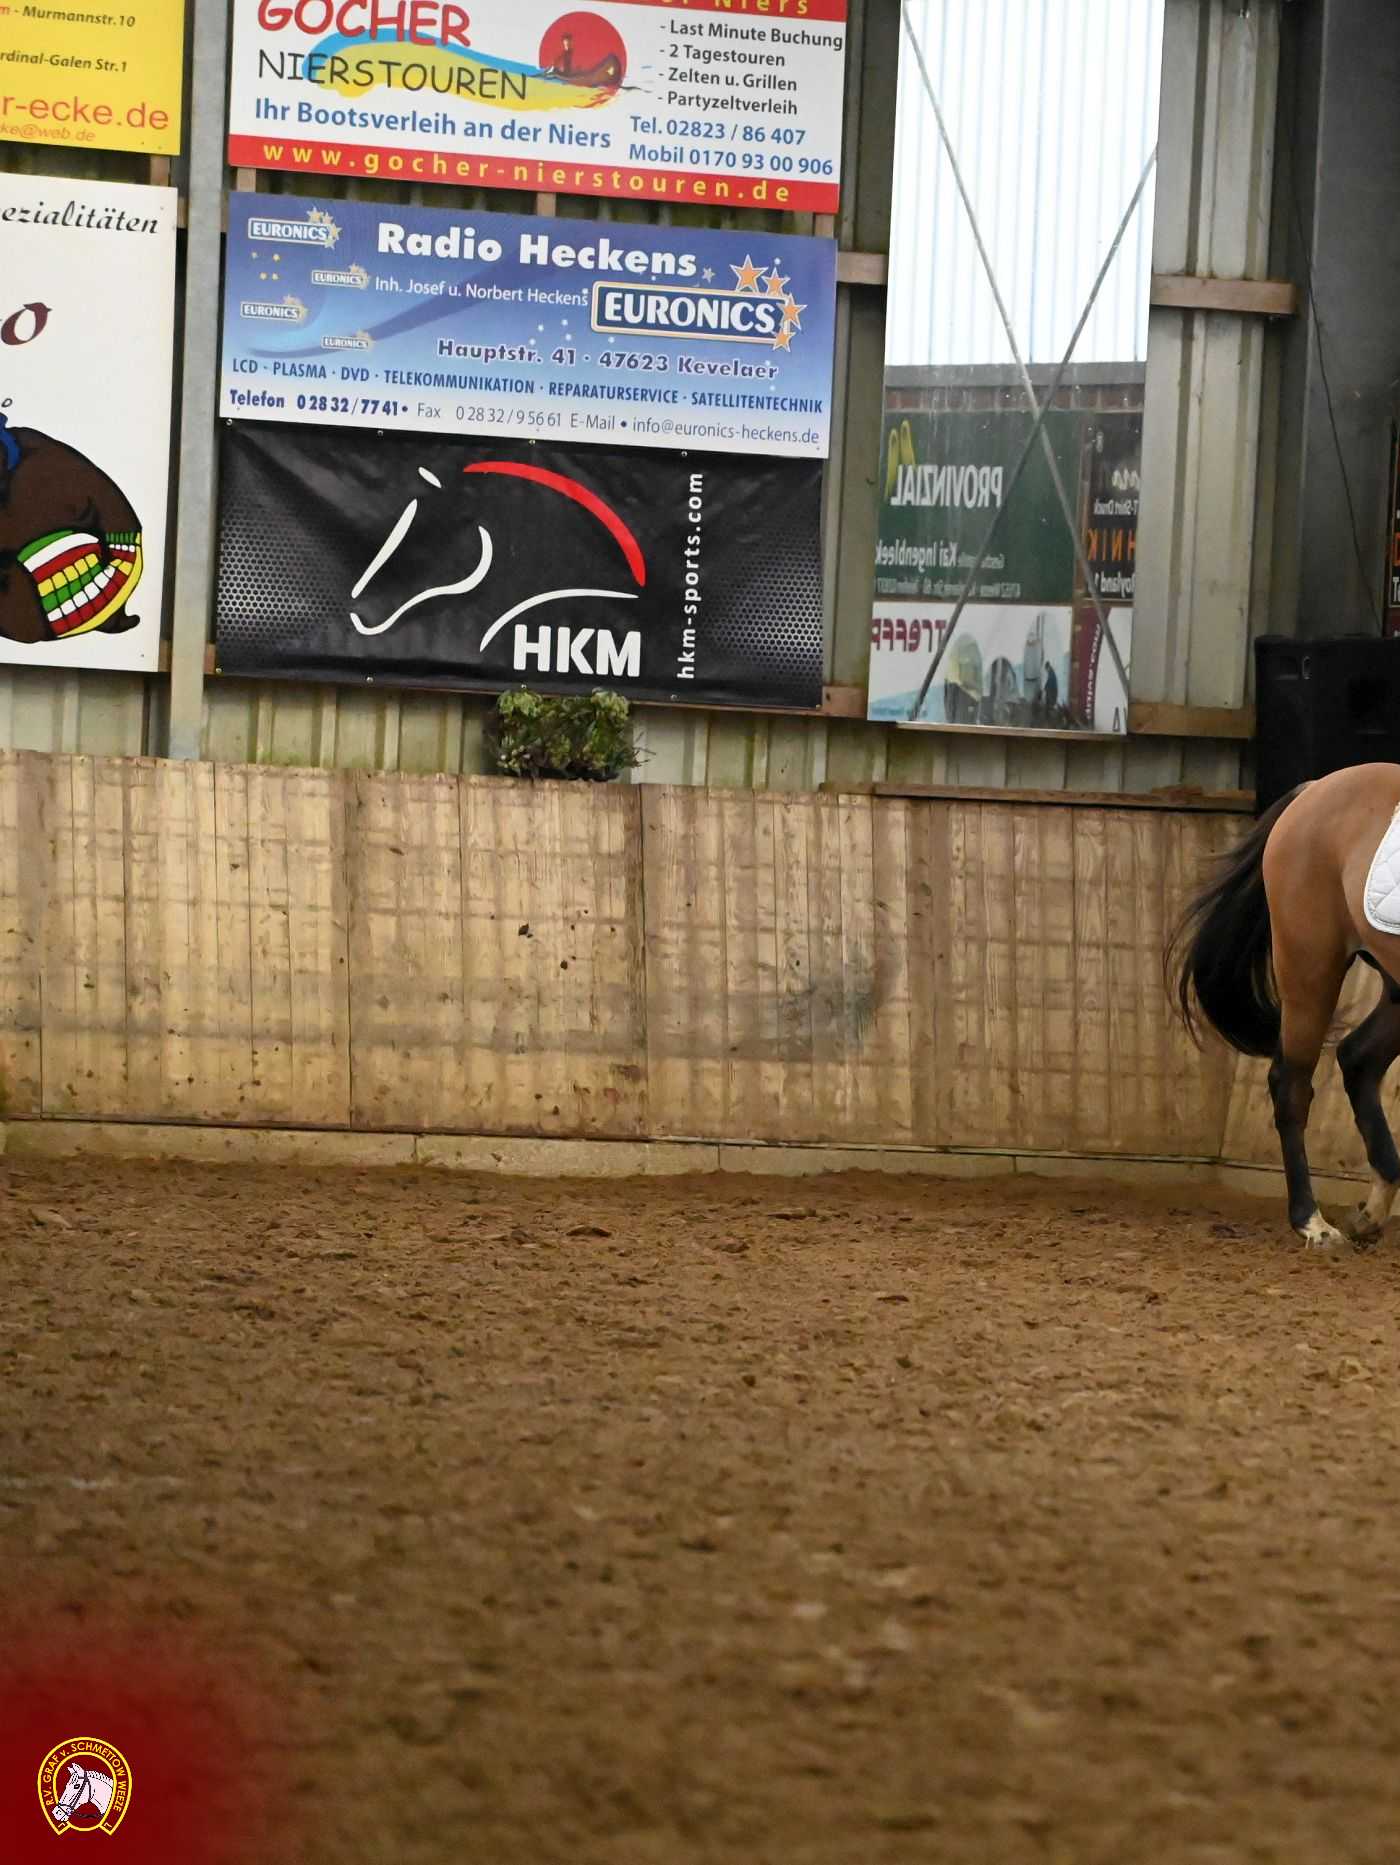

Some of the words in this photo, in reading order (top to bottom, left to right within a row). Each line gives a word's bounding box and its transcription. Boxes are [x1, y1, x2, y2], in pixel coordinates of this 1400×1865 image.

[257, 0, 471, 47] GOCHER
[670, 19, 704, 37] Last
[708, 23, 767, 42] Minute
[770, 28, 844, 52] Buchung
[669, 44, 679, 59] 2
[685, 45, 786, 67] Tagestouren
[258, 49, 527, 100] NIERSTOUREN
[668, 67, 721, 86] Zelten
[725, 73, 740, 87] u.
[743, 74, 798, 92] Grillen
[2, 96, 169, 130] r-ecke.de
[668, 91, 799, 116] Partyzeltverleih
[255, 97, 291, 121] Ihr
[298, 101, 456, 136] Bootsverleih
[464, 120, 493, 138] an
[500, 118, 541, 143] der
[549, 123, 611, 148] Niers
[630, 116, 662, 136] Tel.
[667, 119, 725, 140] 02823
[742, 126, 766, 143] 86
[770, 128, 806, 145] 407
[629, 144, 684, 164] Mobil
[689, 148, 737, 168] 0170
[742, 152, 765, 170] 93
[770, 155, 793, 173] 00
[798, 158, 834, 176] 906
[1, 201, 161, 234] ezialitäten
[252, 223, 328, 241] EURONICS
[378, 222, 502, 262] Radio
[519, 234, 697, 277] Heckens
[314, 272, 362, 285] EURONICS
[375, 276, 402, 292] Inh.
[406, 279, 444, 296] Josef
[448, 285, 462, 297] u.
[465, 284, 524, 302] Norbert
[527, 288, 588, 307] Heckens
[243, 304, 298, 317] EURONICS
[604, 292, 776, 333] EURONICS
[324, 337, 369, 348] EURONICS
[437, 338, 542, 364] Hauptstr.
[551, 348, 576, 365] 41
[600, 351, 669, 372] 47623
[677, 357, 779, 379] Kevelaer
[232, 358, 258, 373] LCD
[273, 362, 327, 379] PLASMA
[340, 367, 370, 382] DVD
[384, 370, 535, 393] TELEKOMMUNIKATION
[549, 382, 678, 404] REPARATURSERVICE
[691, 392, 822, 413] SATELLITENTECHNIK
[230, 389, 284, 408] Telefon
[417, 405, 441, 418] Fax
[570, 413, 615, 430] E-Mail
[633, 417, 819, 445] info@euronics-heckens.de
[676, 473, 704, 680] hkm-sports.com
[514, 624, 641, 677] HKM
